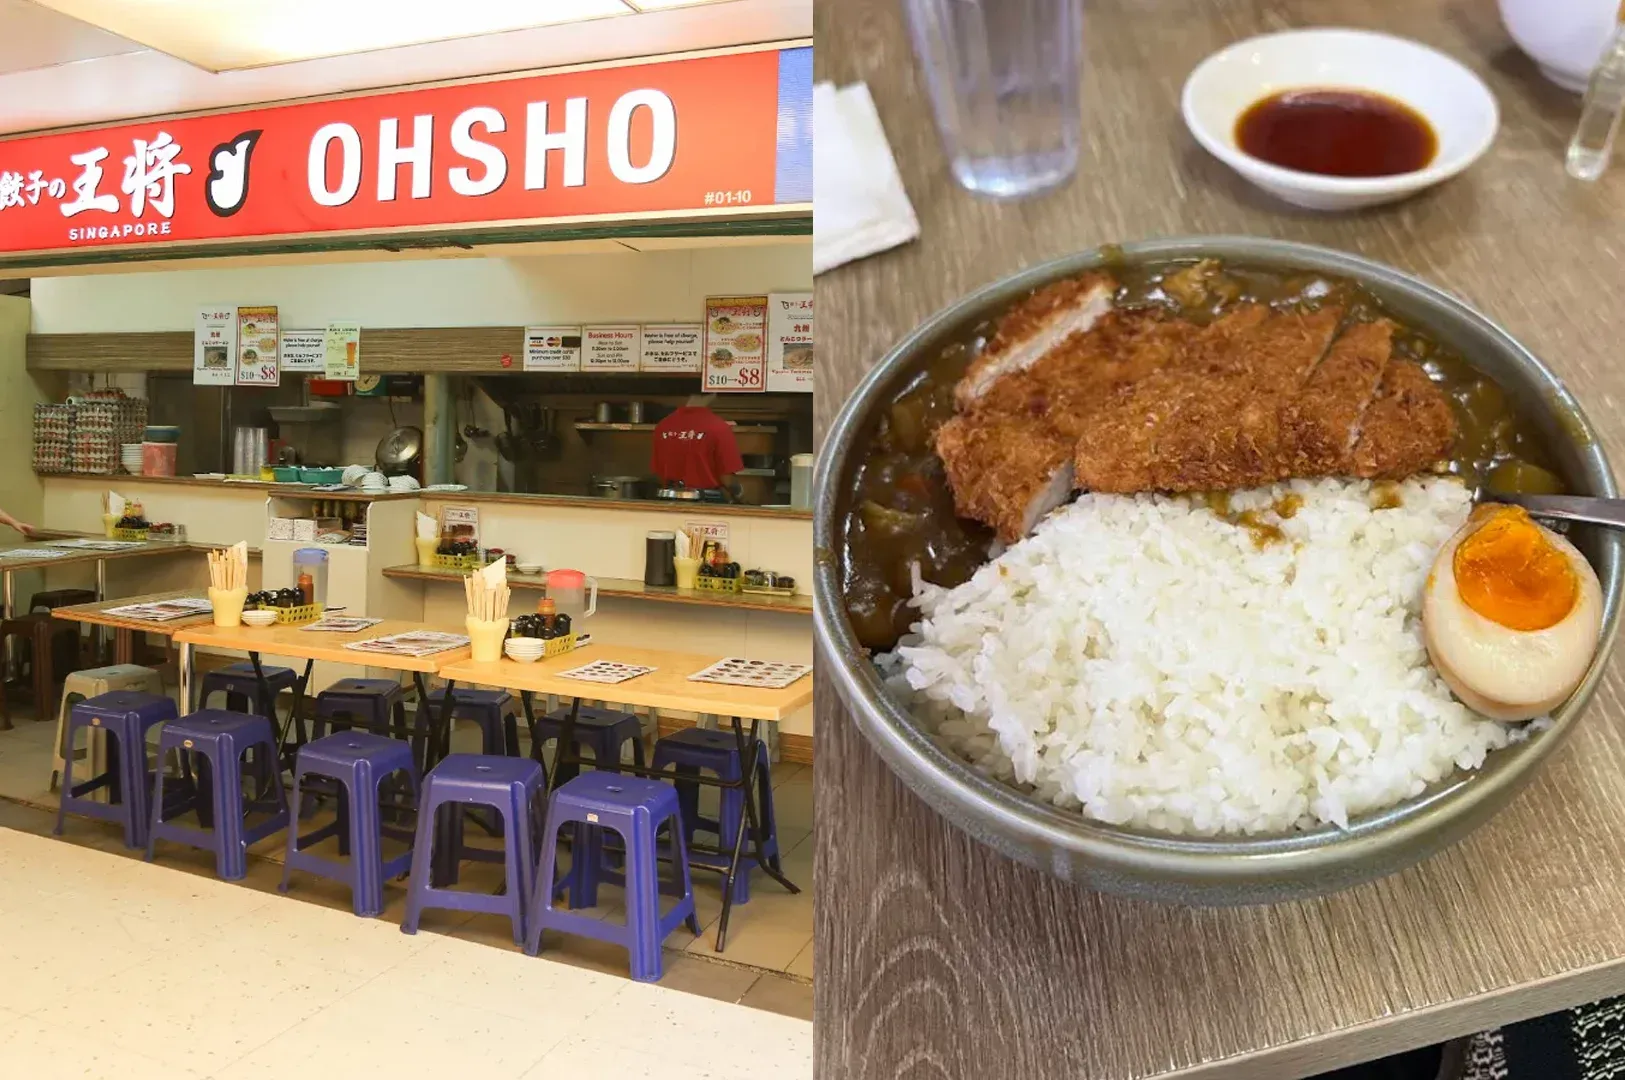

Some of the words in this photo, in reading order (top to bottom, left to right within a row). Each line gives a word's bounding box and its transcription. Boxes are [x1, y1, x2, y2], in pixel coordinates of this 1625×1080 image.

[307, 88, 677, 207] OHSHO
[704, 190, 752, 206] #01-10
[68, 221, 172, 241] SINGAPORE
[240, 370, 255, 380] $10
[261, 364, 276, 380] $8
[709, 374, 728, 386] $10
[738, 367, 760, 387] $8
